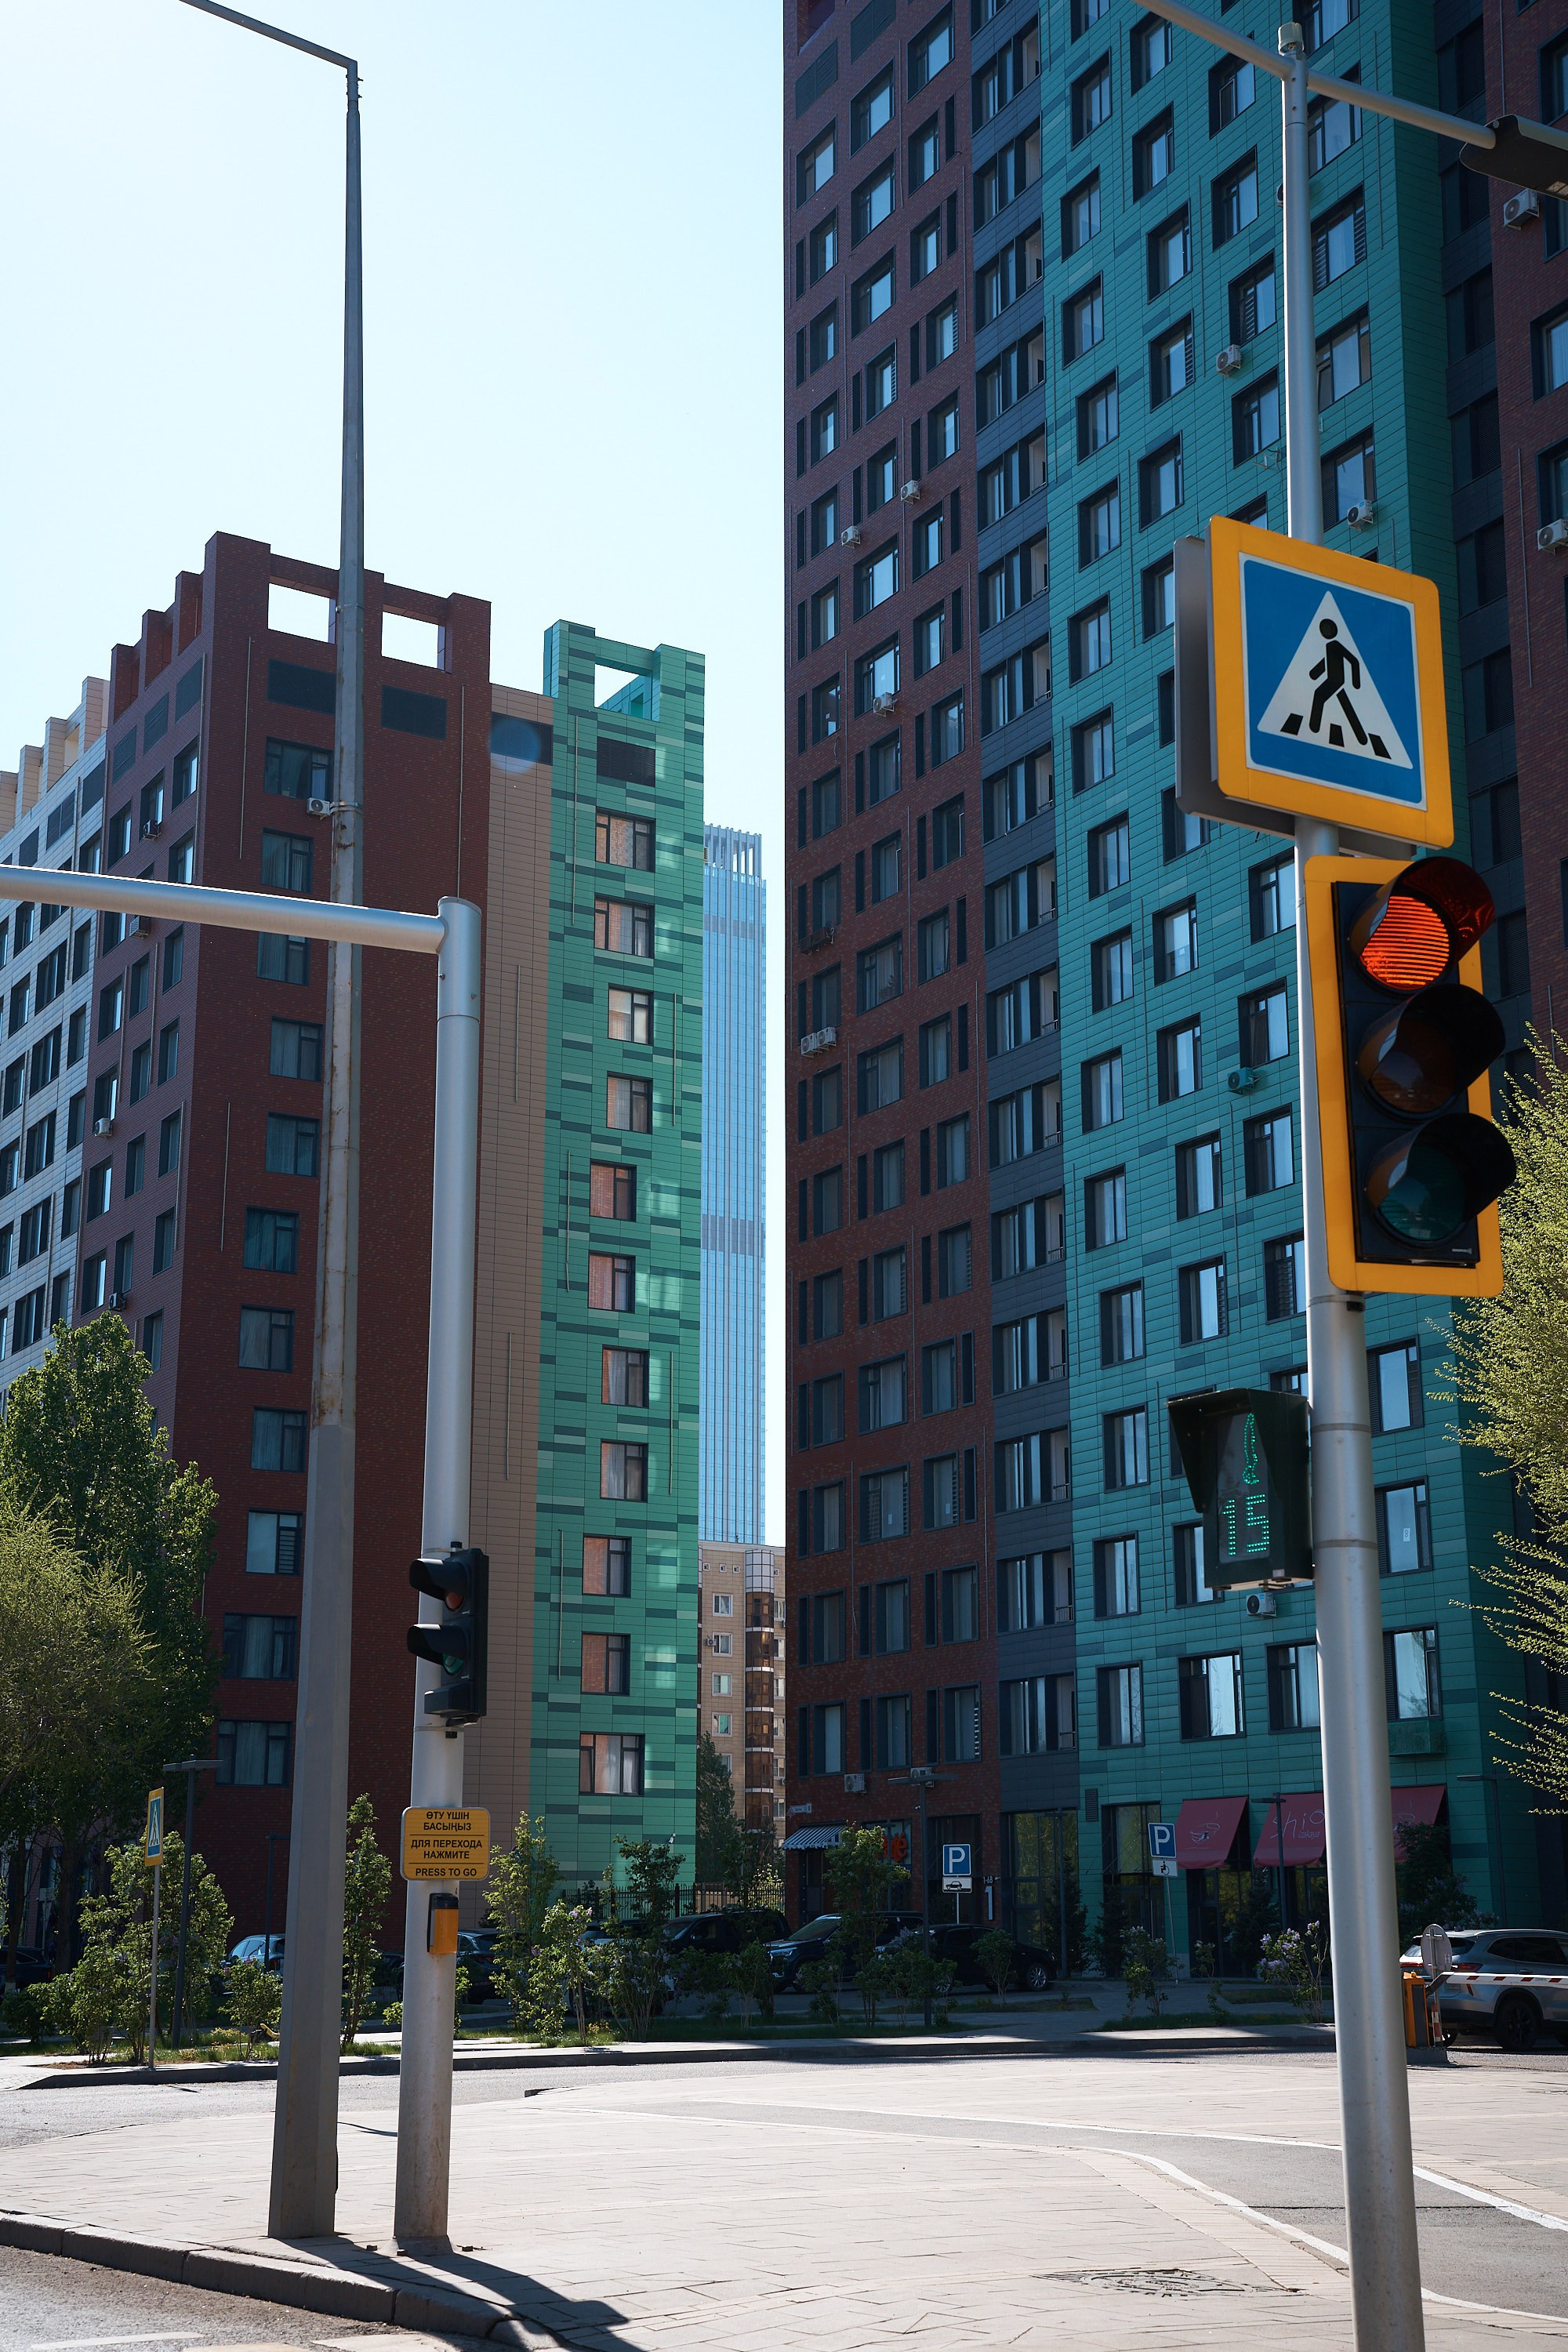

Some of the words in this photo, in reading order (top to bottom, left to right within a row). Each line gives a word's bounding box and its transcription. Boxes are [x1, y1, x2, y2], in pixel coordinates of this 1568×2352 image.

[1221, 1494, 1269, 1555] 15
[423, 1822, 472, 1831] БАСЫҢЫЗ
[1153, 1825, 1171, 1855] P
[1298, 1830, 1320, 1840] izakaya
[411, 1840, 430, 1849] ДЛЯ
[433, 1840, 482, 1849] ПЕРЕХОДА
[949, 1846, 966, 1874] P
[984, 1886, 993, 1920] 1
